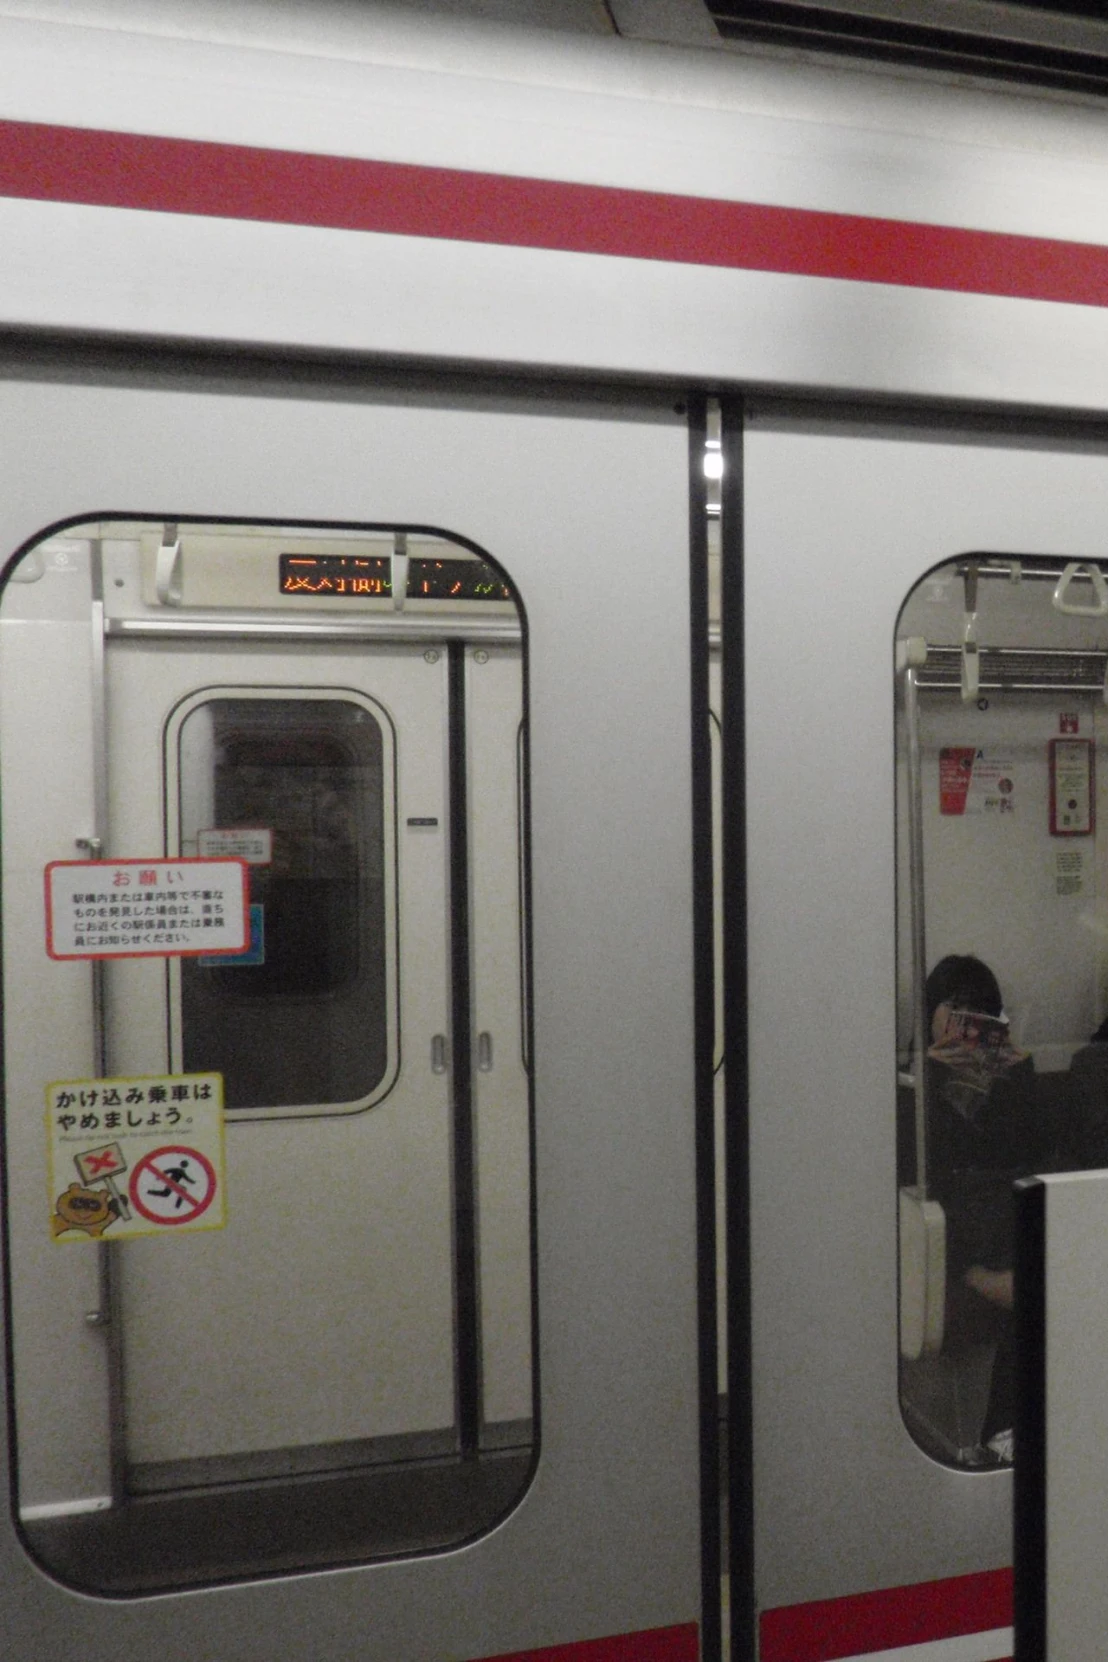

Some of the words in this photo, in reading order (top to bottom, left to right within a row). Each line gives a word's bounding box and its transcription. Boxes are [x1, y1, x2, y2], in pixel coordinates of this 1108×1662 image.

[112, 870, 184, 887] お願い
[56, 1083, 213, 1109] かけ込み乗車は
[57, 1107, 193, 1131] やめましょう。
